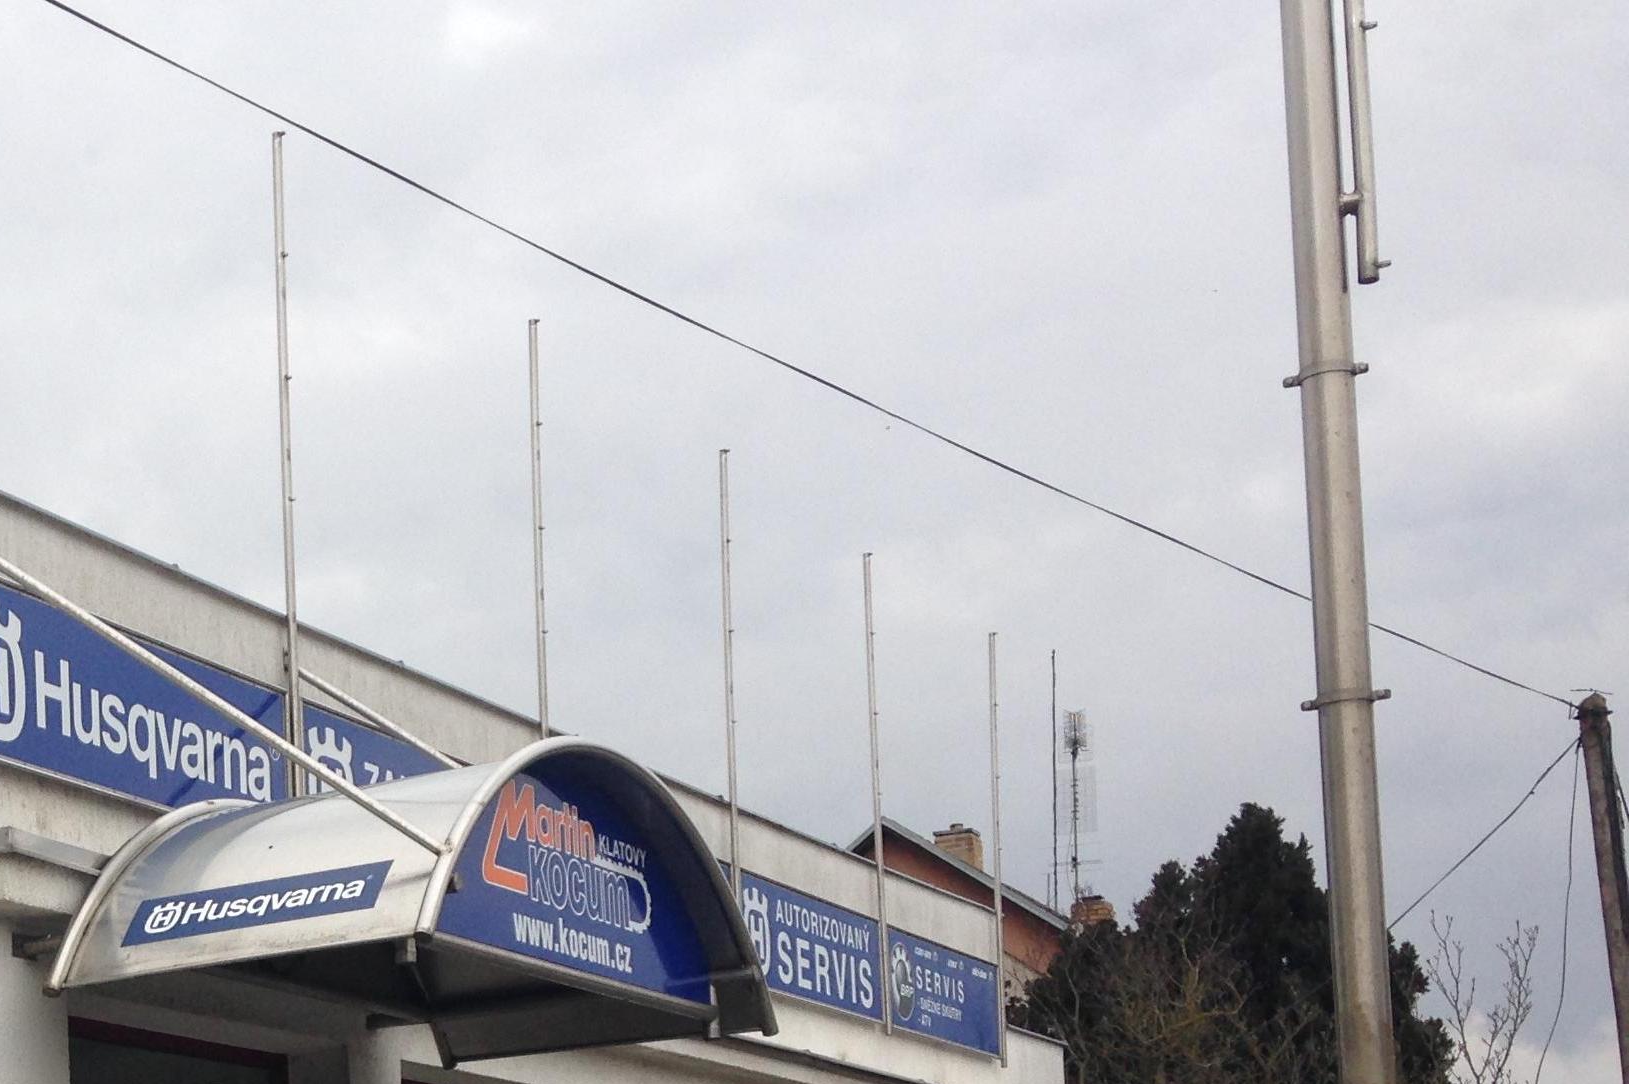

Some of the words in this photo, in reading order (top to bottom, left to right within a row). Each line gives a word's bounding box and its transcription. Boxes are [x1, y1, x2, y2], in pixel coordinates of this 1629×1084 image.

[34, 649, 273, 802] Husqvarna
[484, 779, 596, 875] Martin
[598, 833, 647, 868] KLATOVY
[181, 879, 366, 925] Husqvarna
[776, 899, 870, 953] AUTORIZOVANÝ
[513, 912, 633, 974] www.kocum.cz
[777, 931, 874, 1009] SERVIS
[915, 965, 965, 1004] SERVIS
